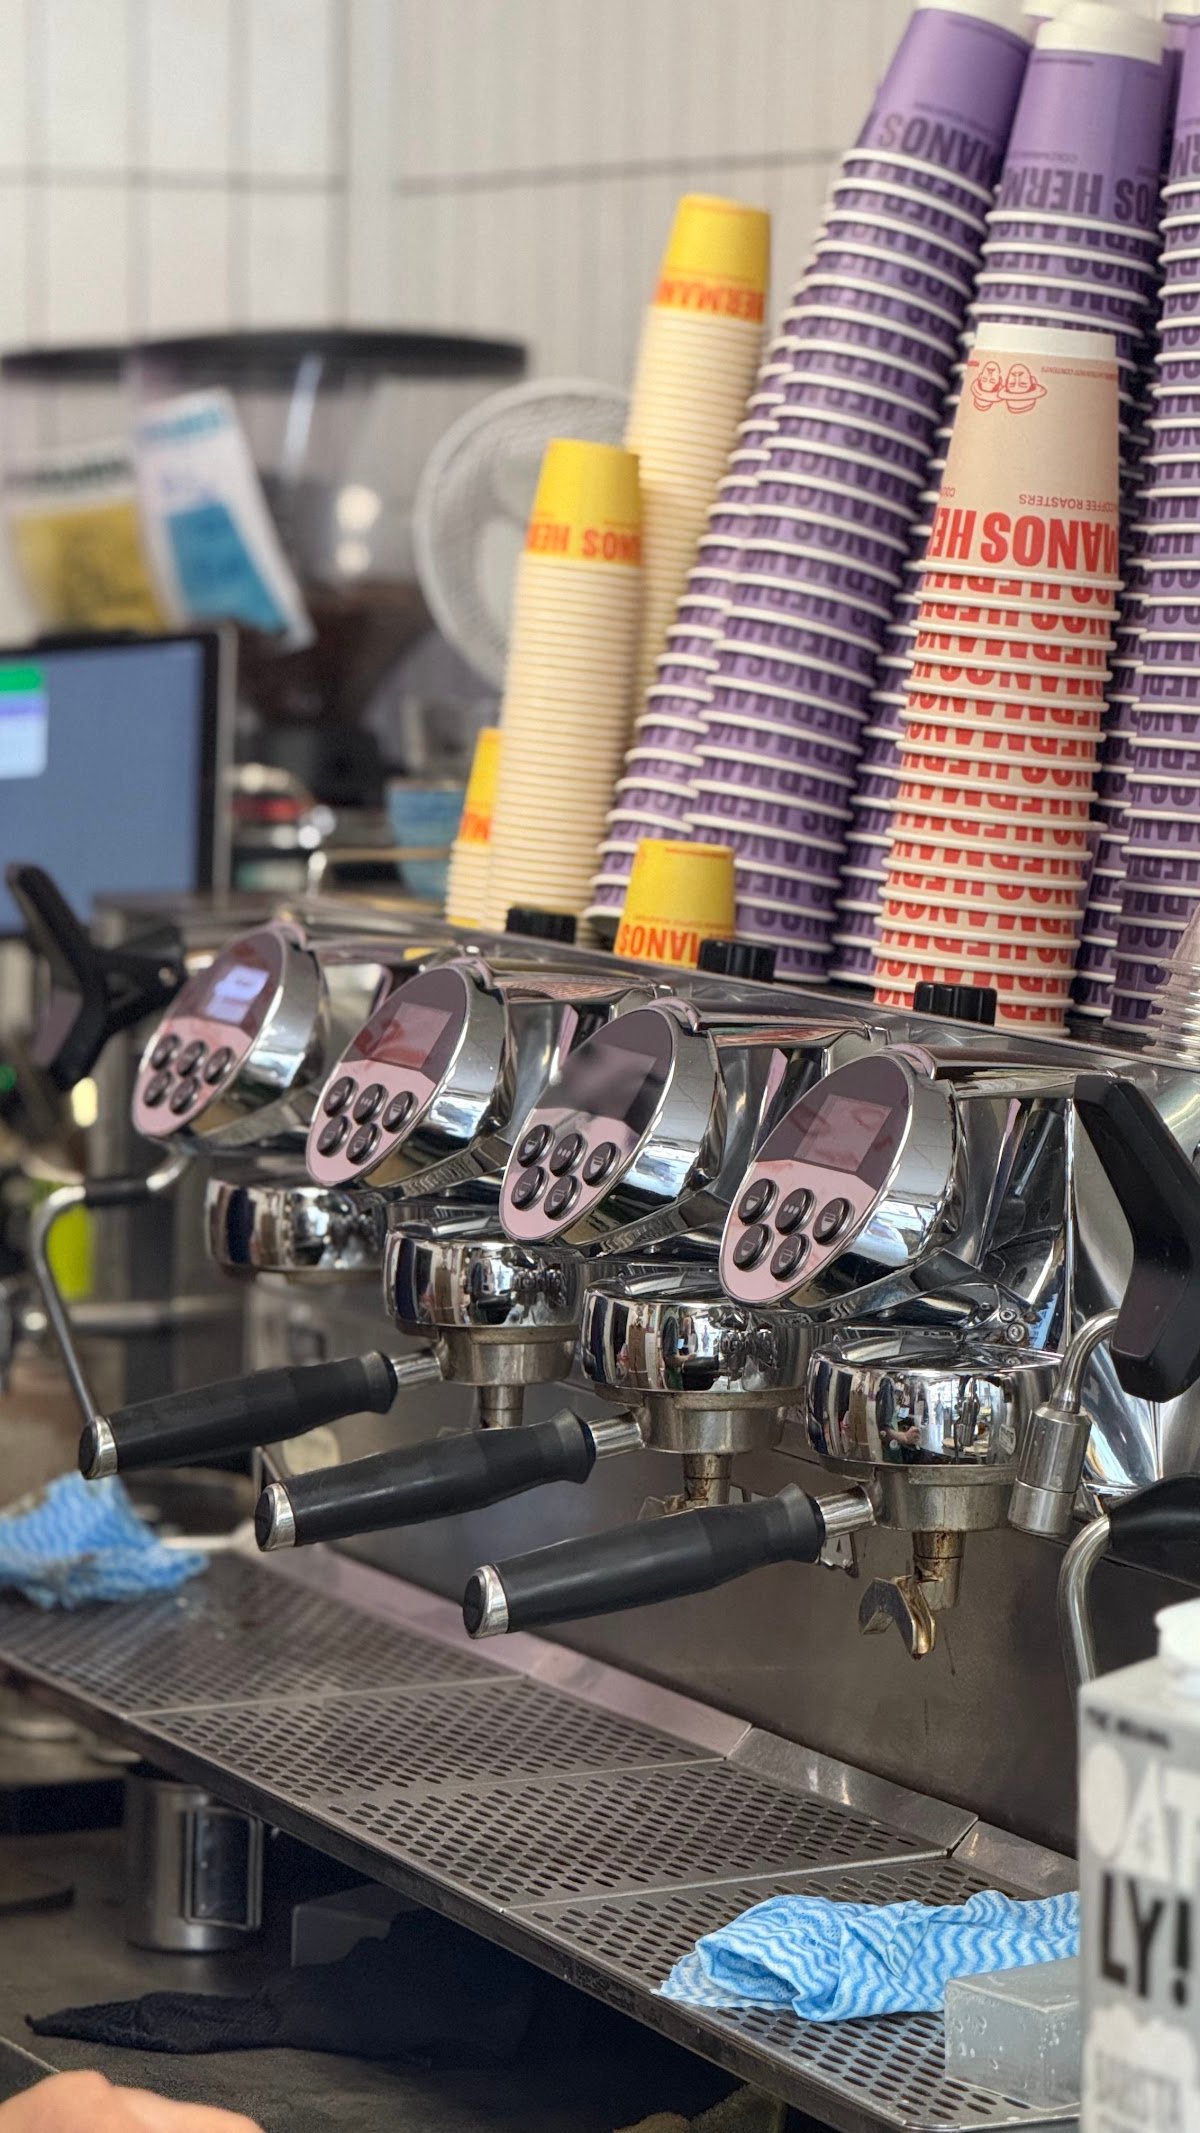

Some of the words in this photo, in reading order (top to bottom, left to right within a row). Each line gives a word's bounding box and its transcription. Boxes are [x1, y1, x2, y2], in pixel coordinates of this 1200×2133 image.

[1018, 493, 1084, 510] ROASTERS
[927, 507, 978, 561] HE
[981, 511, 1118, 575] MANOS
[1085, 1742, 1200, 1890] OAT
[1099, 1869, 1194, 2007] LY!
